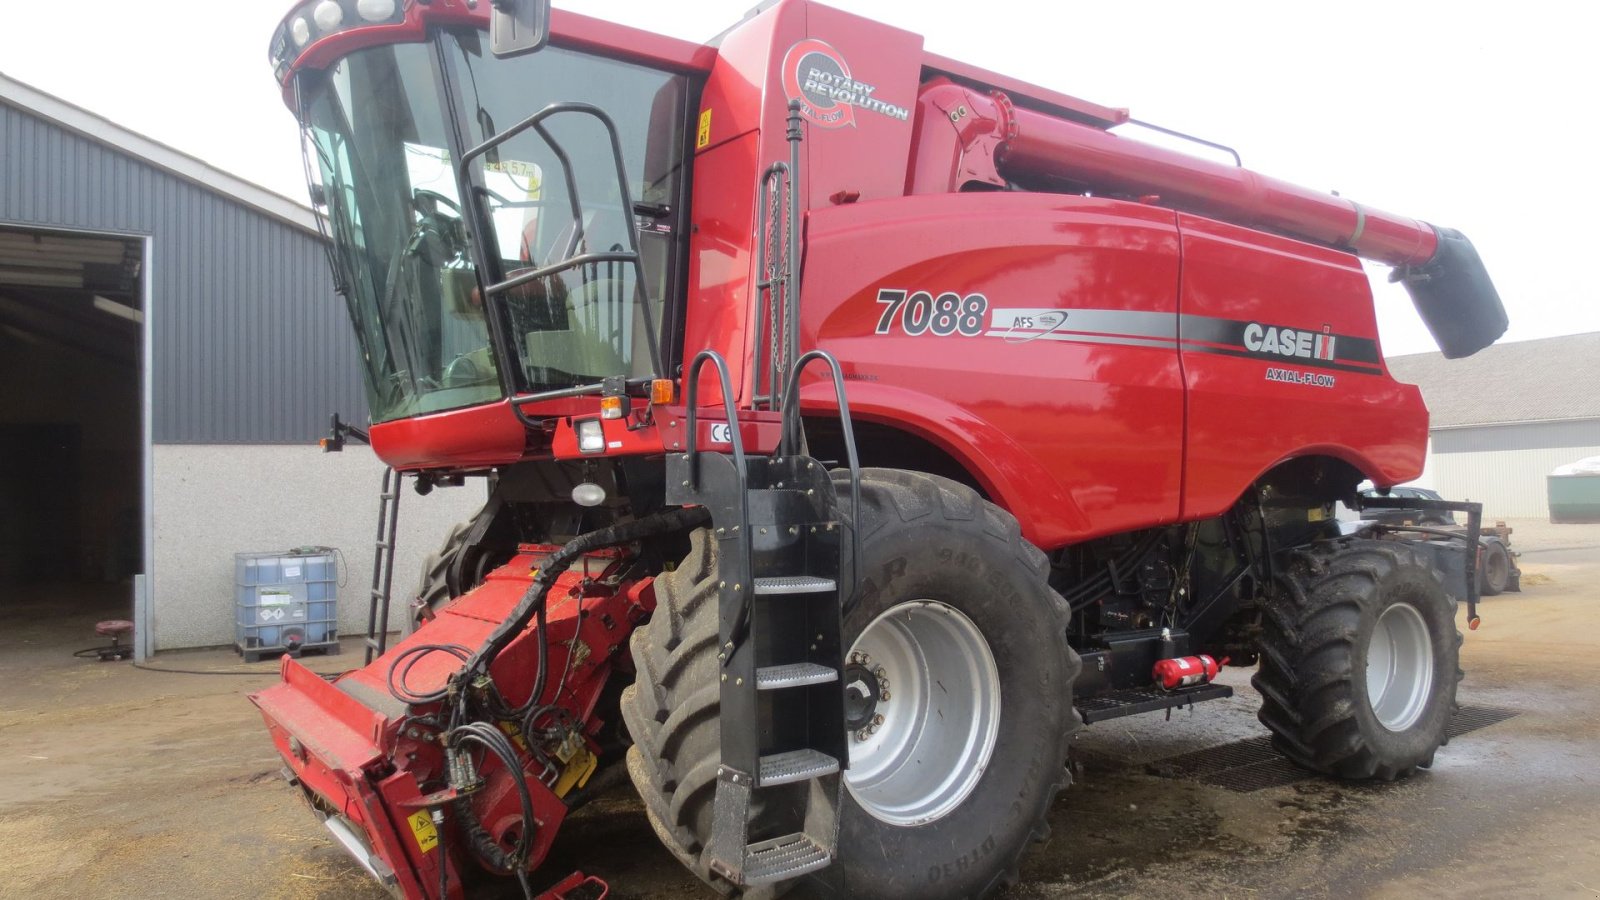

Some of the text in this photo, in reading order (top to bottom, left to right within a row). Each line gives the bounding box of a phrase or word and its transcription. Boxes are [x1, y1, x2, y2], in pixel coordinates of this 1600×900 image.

[808, 67, 876, 97] ROTARY
[799, 100, 843, 121] XIAL-FLOW
[803, 79, 909, 121] REVOLUTION
[875, 288, 988, 337] 7088
[1013, 316, 1034, 328] AFS
[1243, 322, 1312, 359] CASE
[1265, 367, 1335, 388] AXIAL-FLOW
